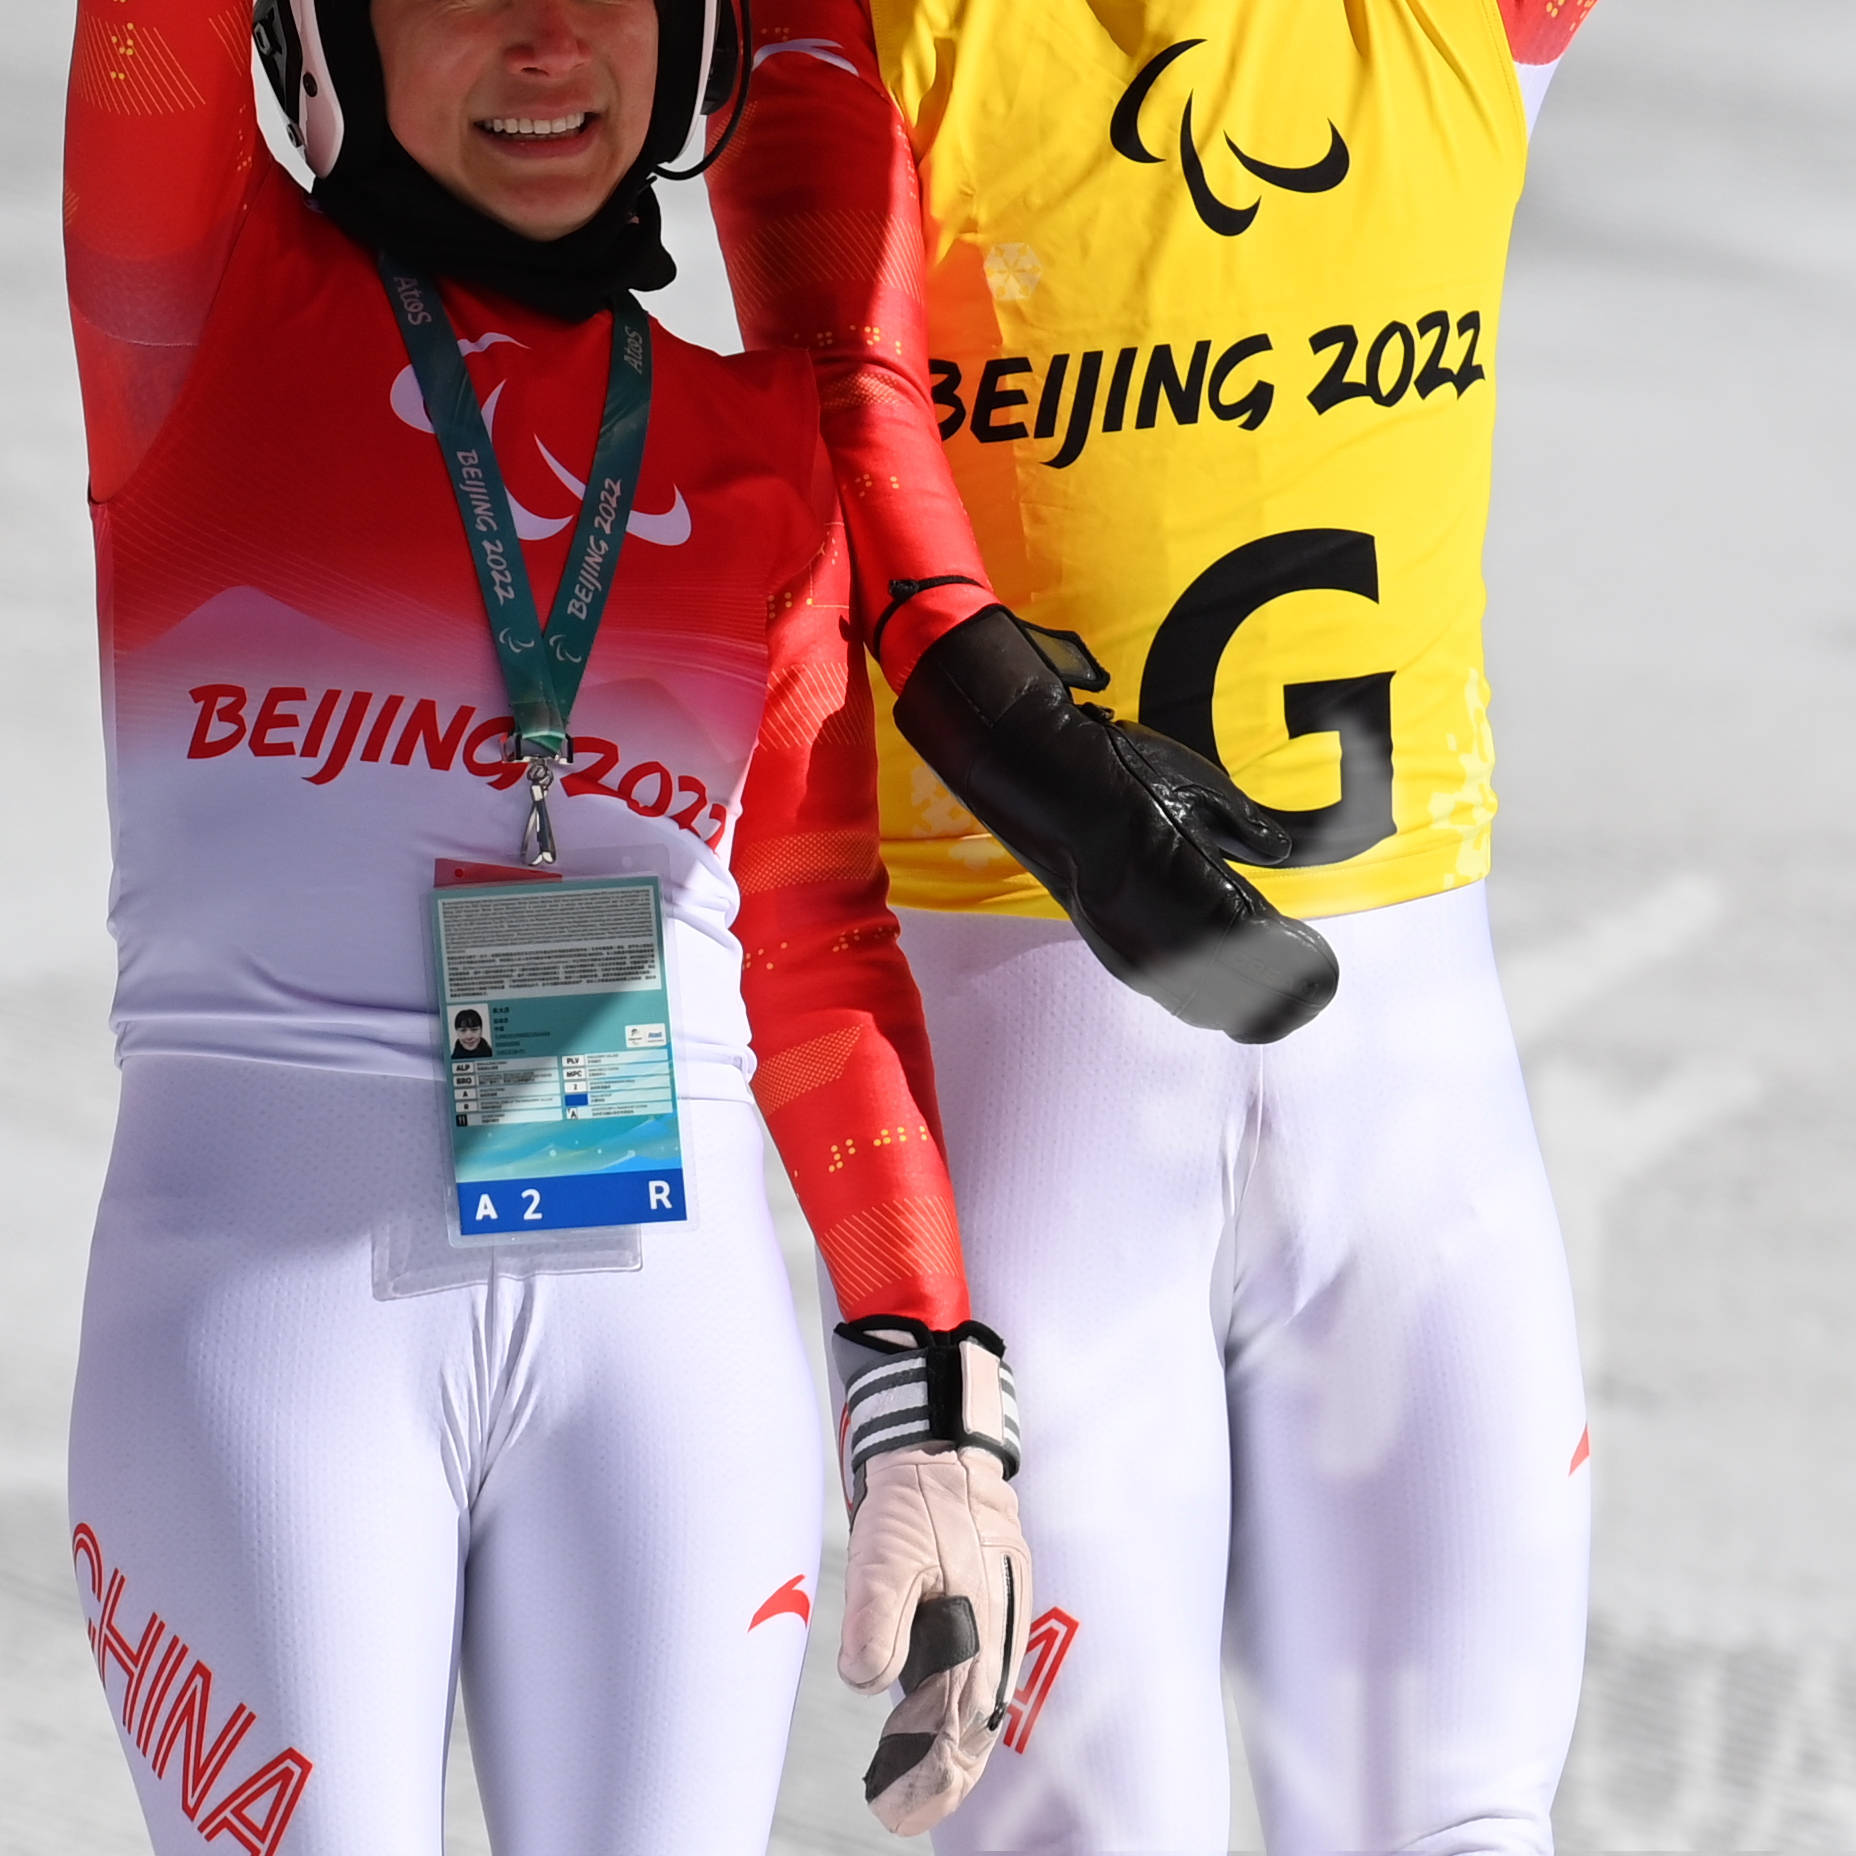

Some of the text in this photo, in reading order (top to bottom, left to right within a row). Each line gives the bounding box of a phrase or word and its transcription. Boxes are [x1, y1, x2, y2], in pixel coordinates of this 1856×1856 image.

[929, 309, 1487, 470] BEIJING 2022
[456, 448, 516, 607] BEIJING 2022
[566, 477, 623, 621] BEIJING 2022
[187, 683, 530, 791] BEIJING
[1138, 527, 1399, 870] G
[475, 1179, 673, 1221] A 2 R
[72, 1522, 314, 1856] CHINA
